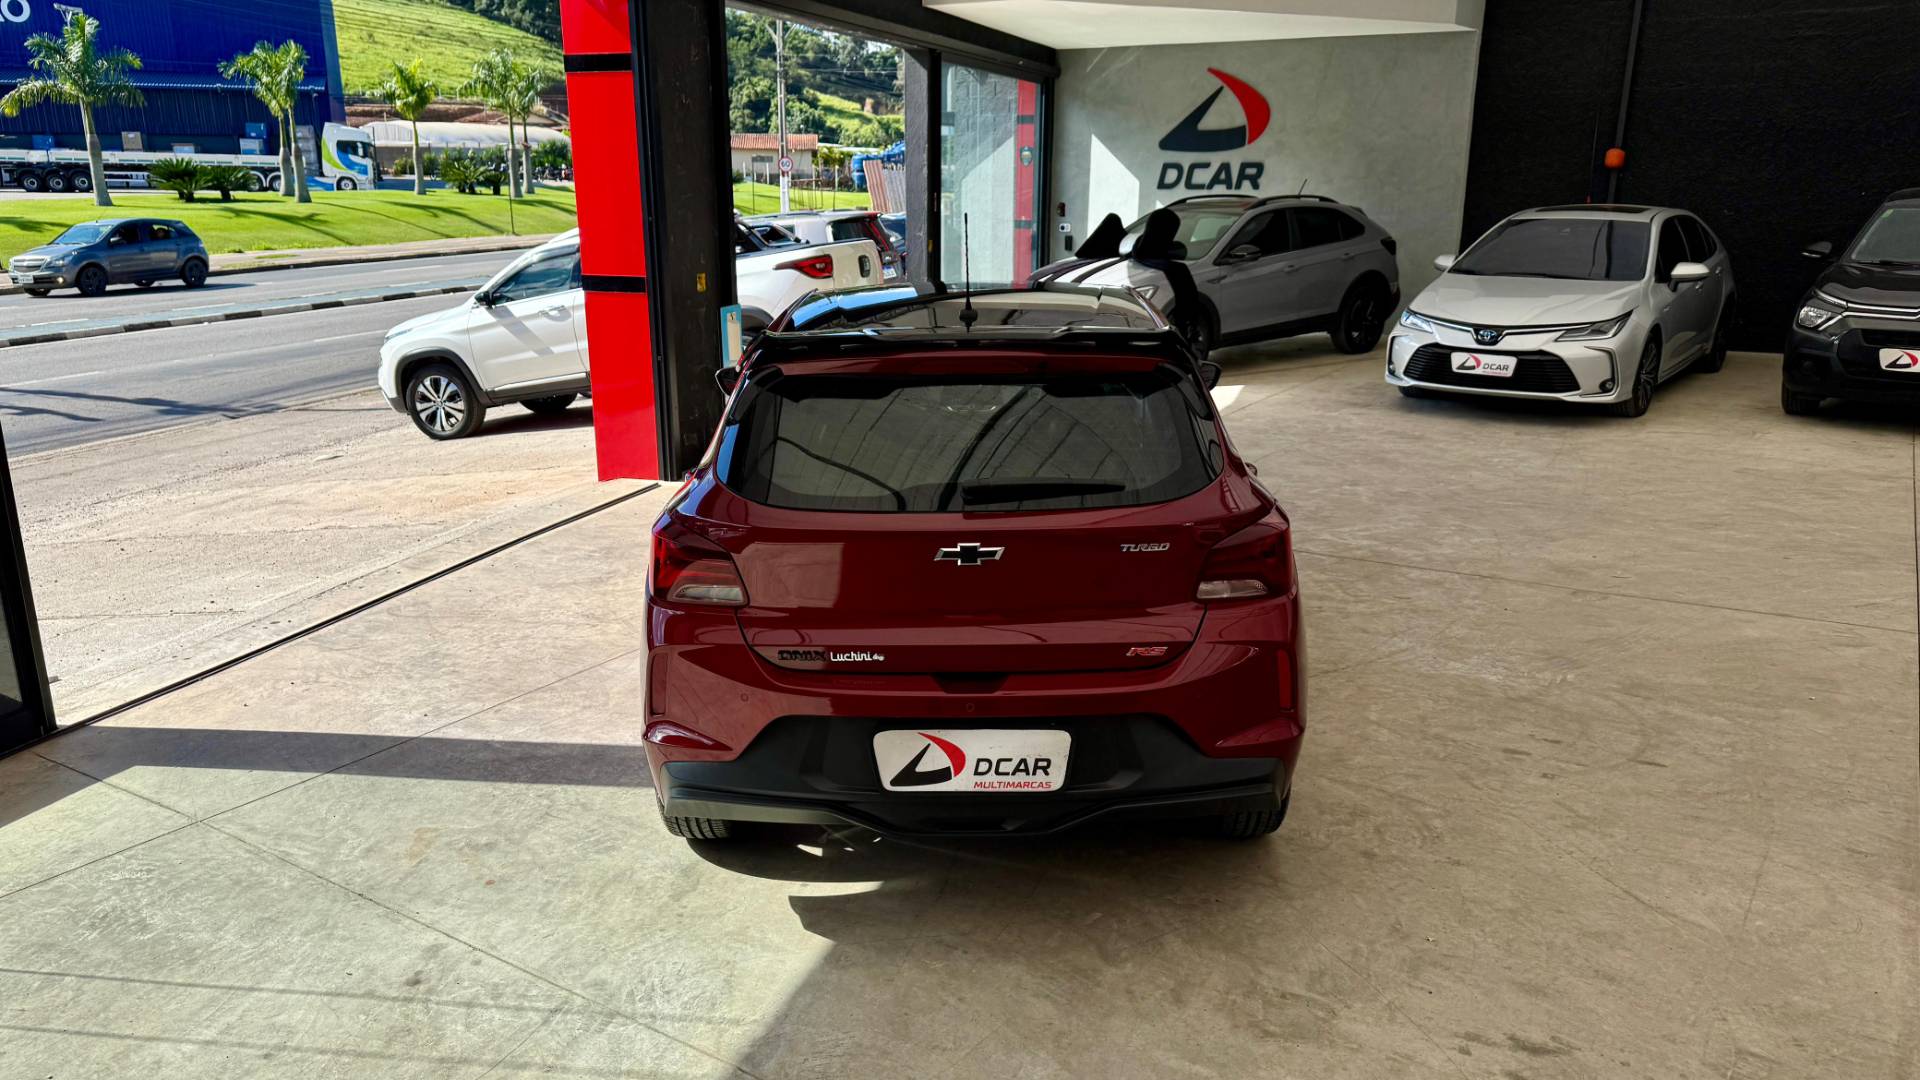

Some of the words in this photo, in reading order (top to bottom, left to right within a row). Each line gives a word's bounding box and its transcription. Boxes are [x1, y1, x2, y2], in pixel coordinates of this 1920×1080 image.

[1156, 162, 1265, 190] DCAR
[1482, 363, 1510, 371] DCAR
[1120, 543, 1170, 551] TURBO
[830, 651, 873, 661] Luchini
[973, 758, 1052, 776] DCAR
[973, 781, 1053, 789] MULTIMARCAS
